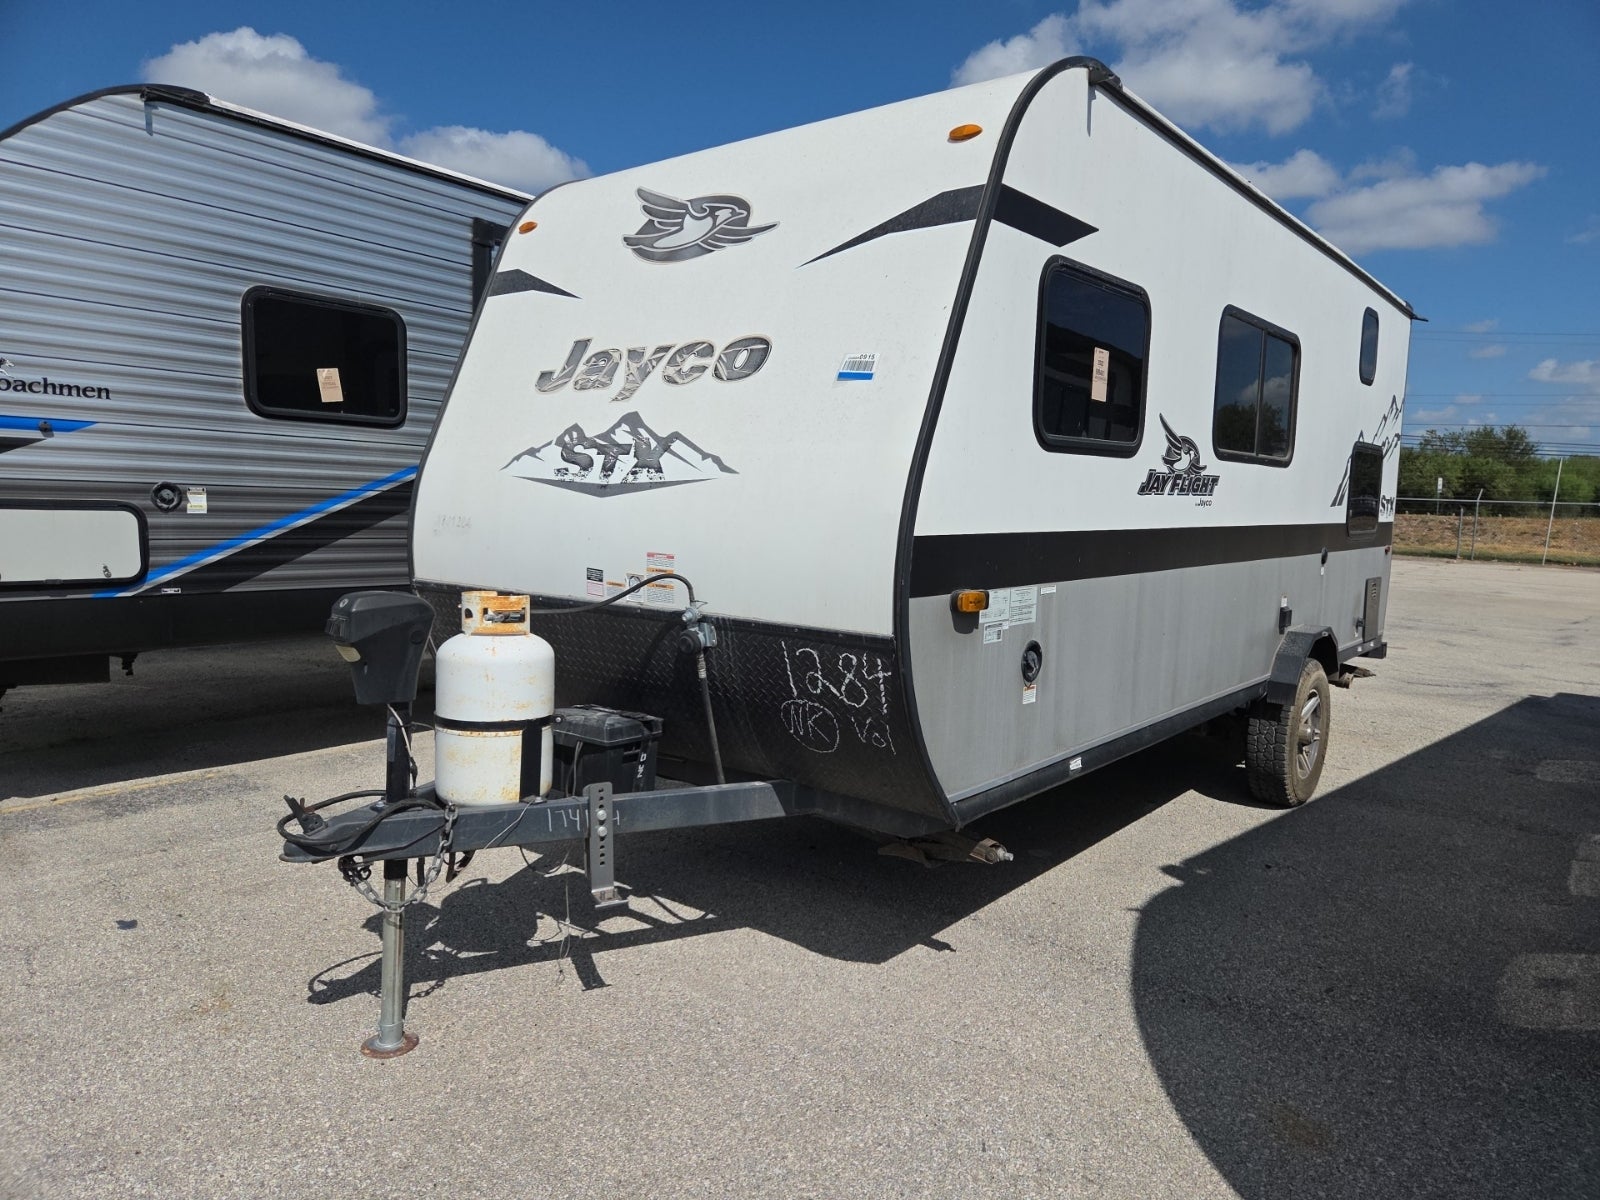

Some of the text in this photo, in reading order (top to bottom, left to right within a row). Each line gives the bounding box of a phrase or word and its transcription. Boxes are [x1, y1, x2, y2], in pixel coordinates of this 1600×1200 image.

[536, 335, 772, 403] Jayco
[554, 437, 668, 486] STX
[1137, 469, 1220, 497] JAY FLIGHT
[1380, 495, 1395, 518] STX
[780, 640, 892, 715] 1284
